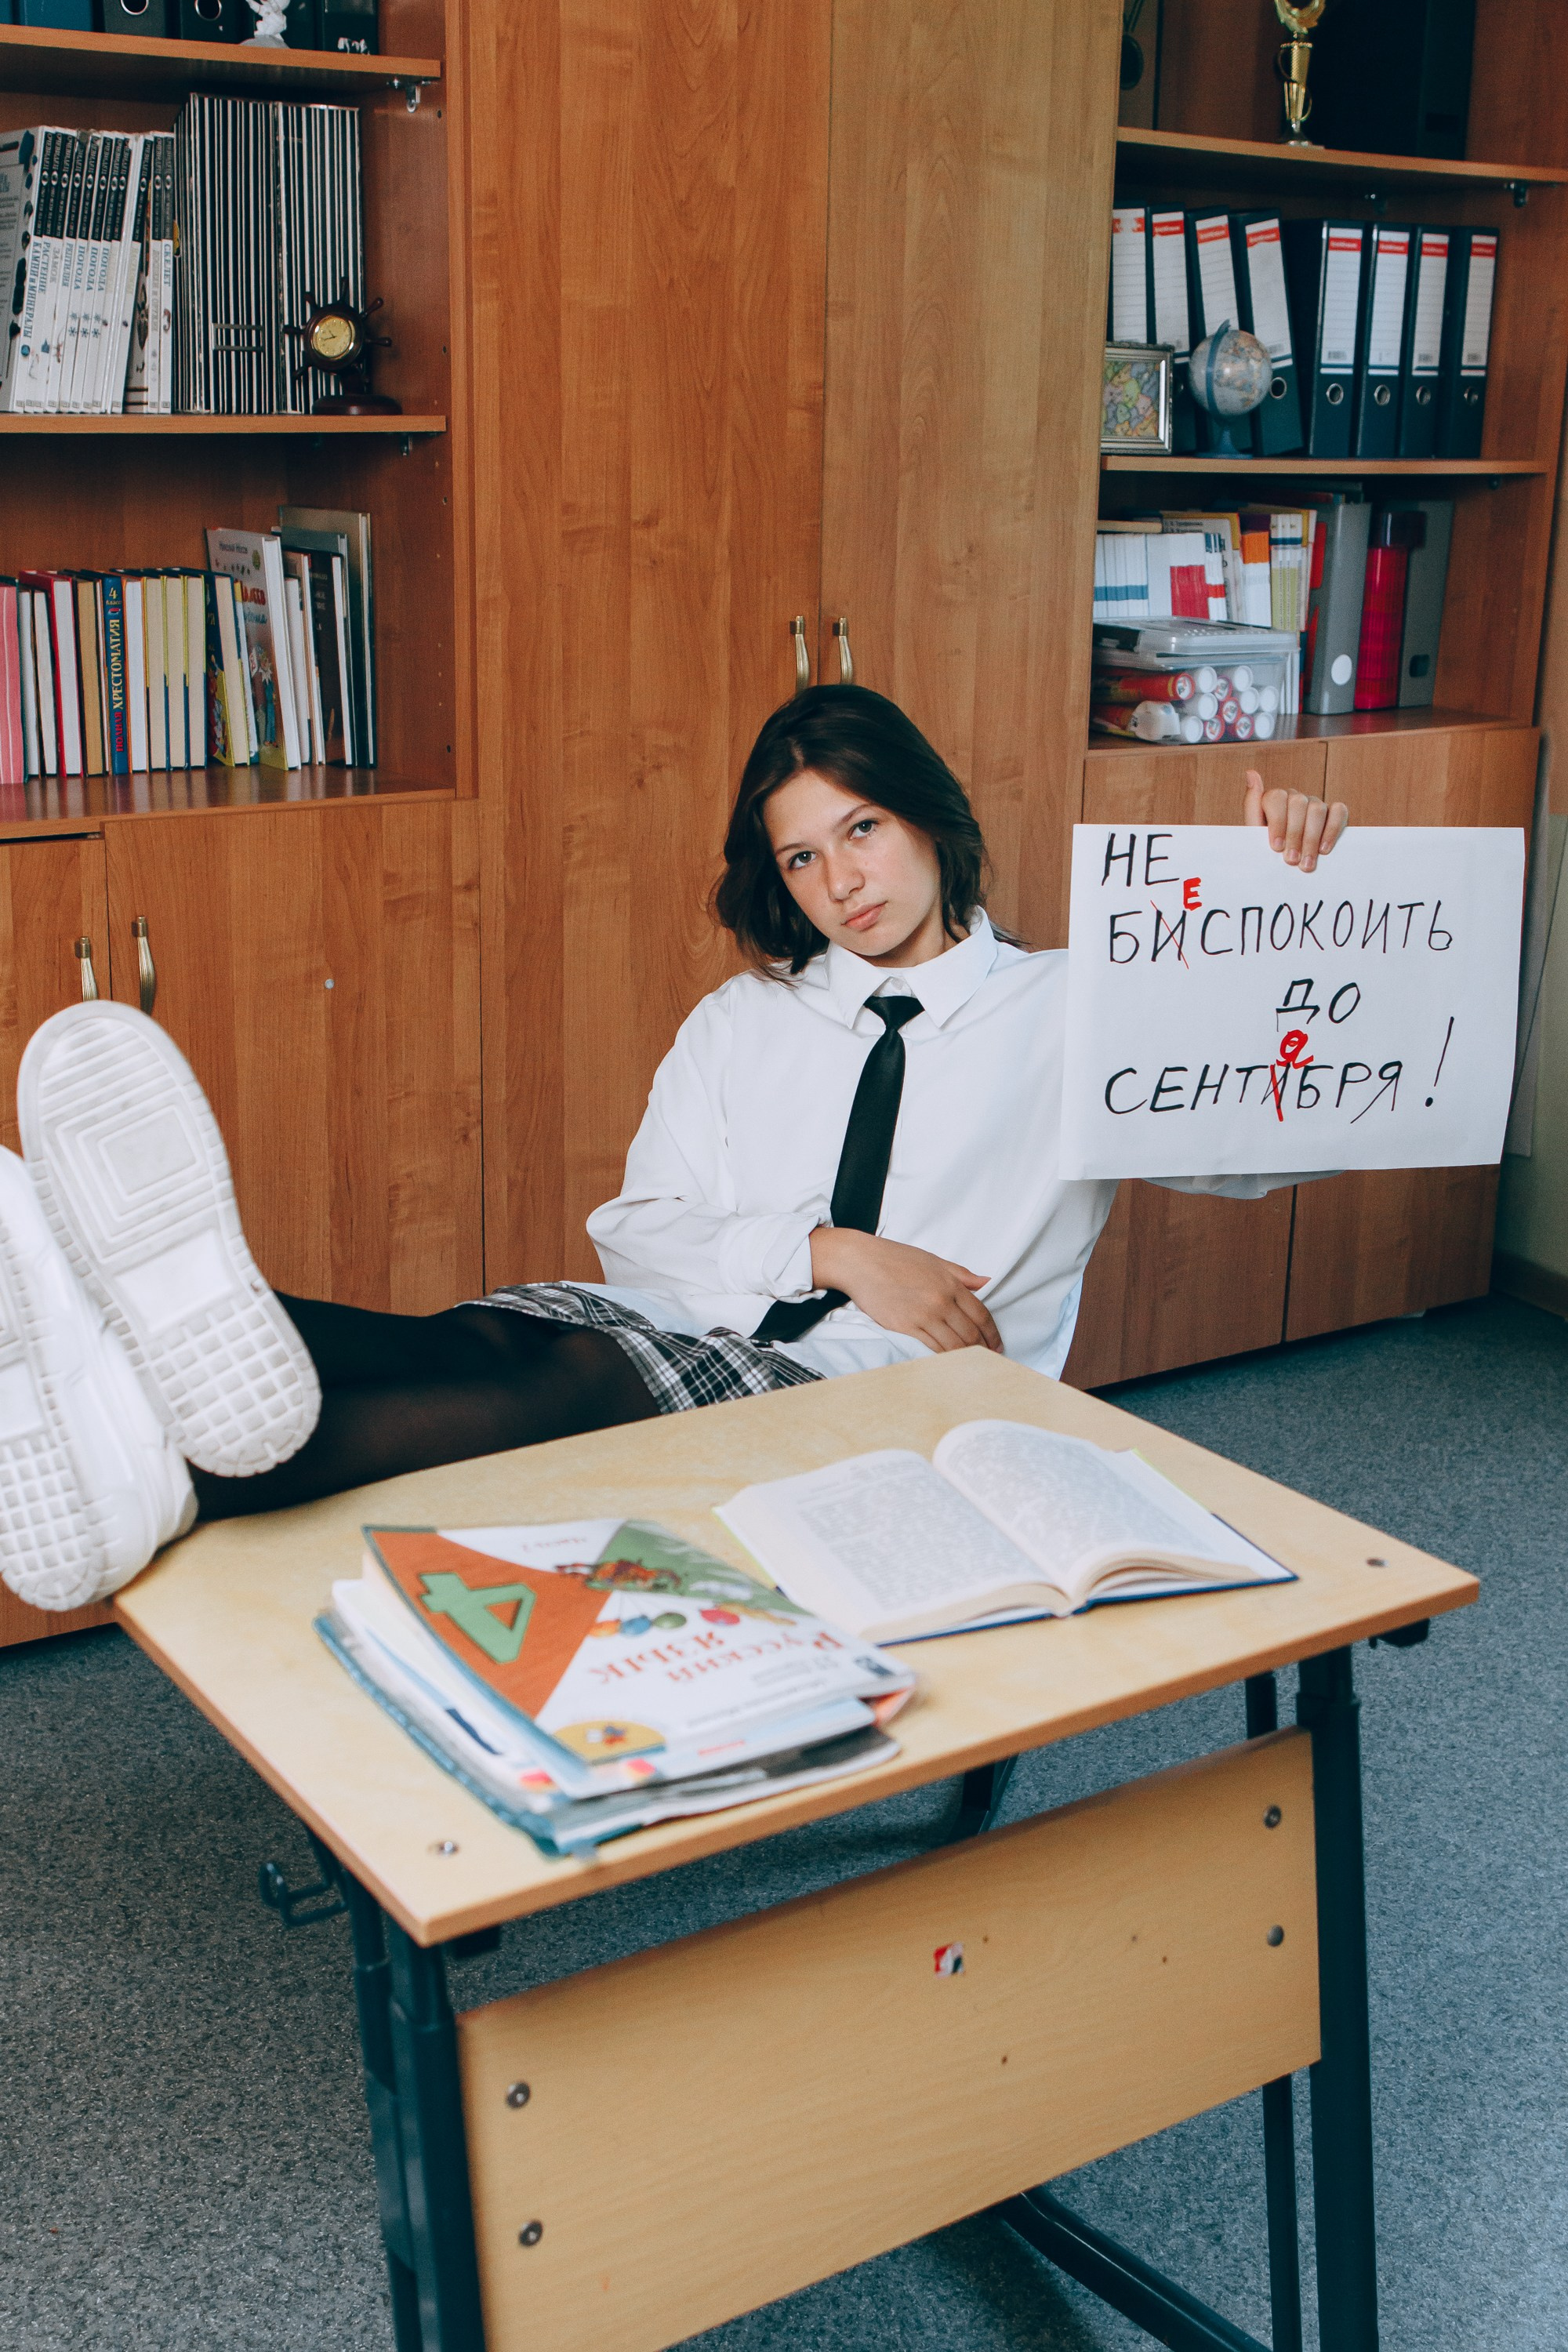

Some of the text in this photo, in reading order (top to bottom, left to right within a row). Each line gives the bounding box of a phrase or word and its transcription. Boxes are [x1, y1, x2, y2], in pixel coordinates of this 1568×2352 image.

[29, 241, 42, 278] КАМНИ
[38, 241, 51, 294] РАСТЕНИЕ
[49, 247, 60, 283] ЗАМОК
[74, 245, 85, 290] ПОГОДА
[86, 246, 99, 291] ПОГОДА
[97, 247, 110, 292] ПОГОДА
[163, 243, 172, 287] СКЕЛЕТ
[23, 283, 38, 338] МИНЕРАЛЫ
[108, 587, 118, 600] 4
[109, 619, 125, 752] ПОЛНАЯ ХРЕСТОМАТИЯ
[1102, 833, 1179, 887] НЕ
[1275, 978, 1362, 1033] ДО
[418, 1570, 538, 1665] 4
